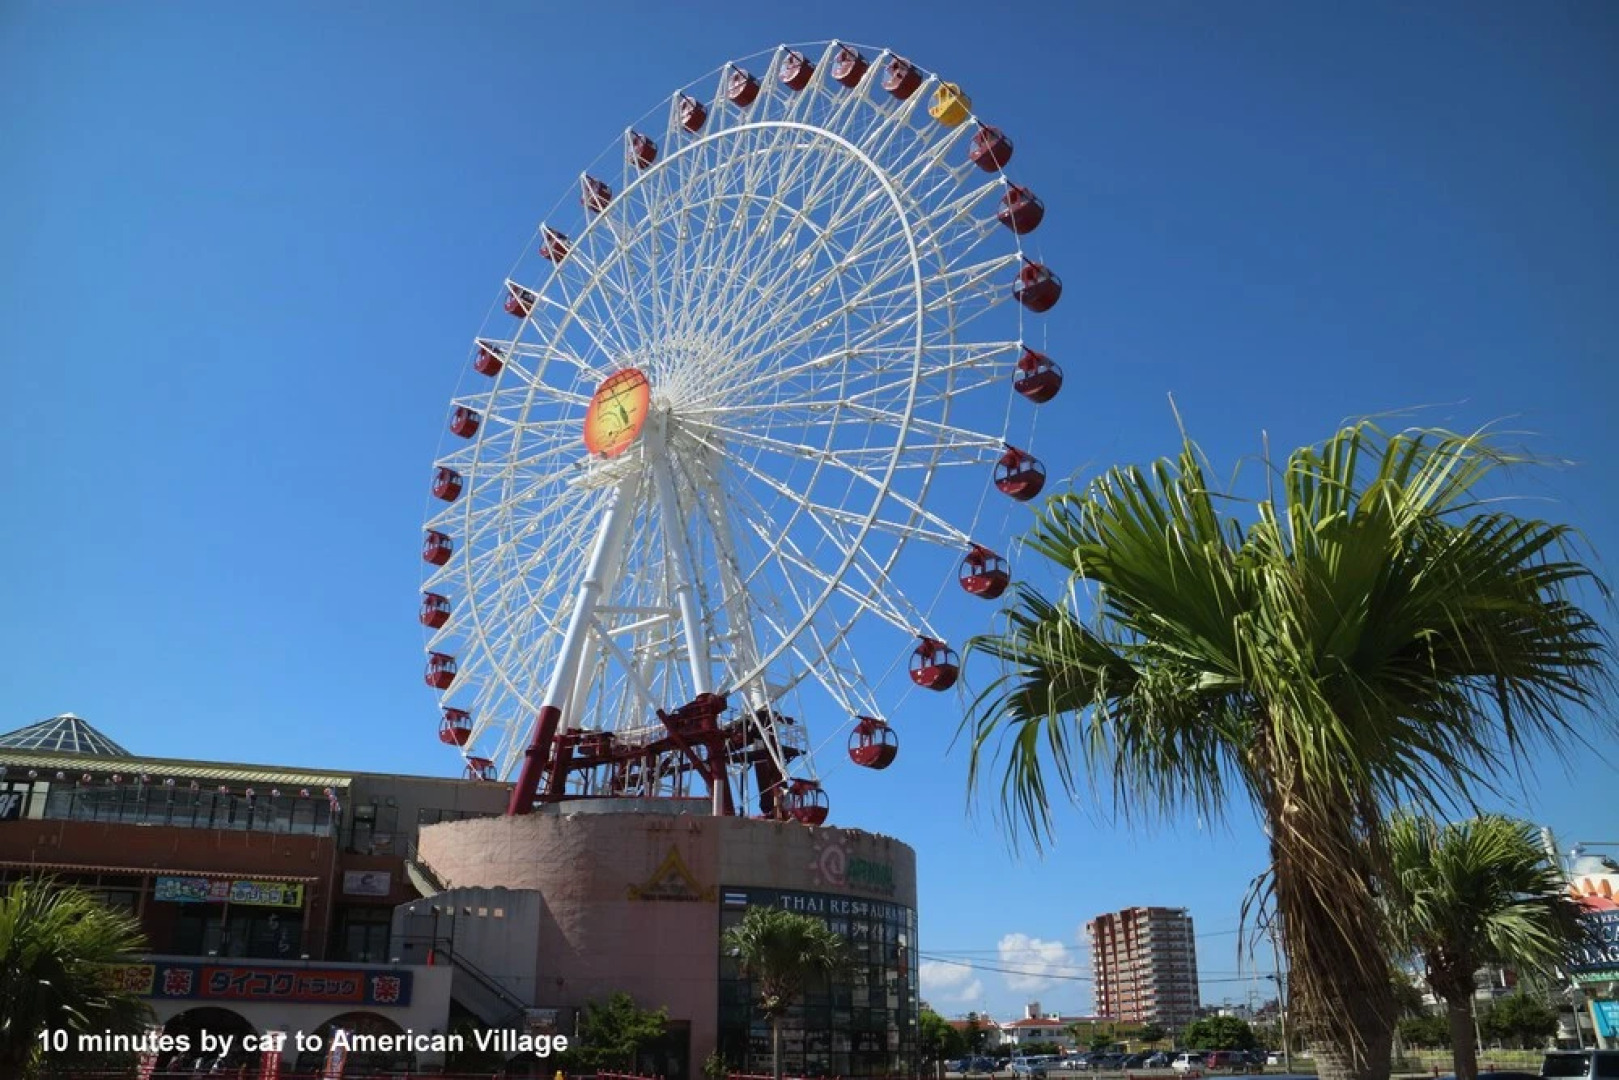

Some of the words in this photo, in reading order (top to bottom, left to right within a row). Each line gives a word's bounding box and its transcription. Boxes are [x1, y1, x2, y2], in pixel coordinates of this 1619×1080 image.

[781, 896, 824, 911] THAI
[163, 967, 194, 995] 薬
[371, 973, 401, 1003] 薬
